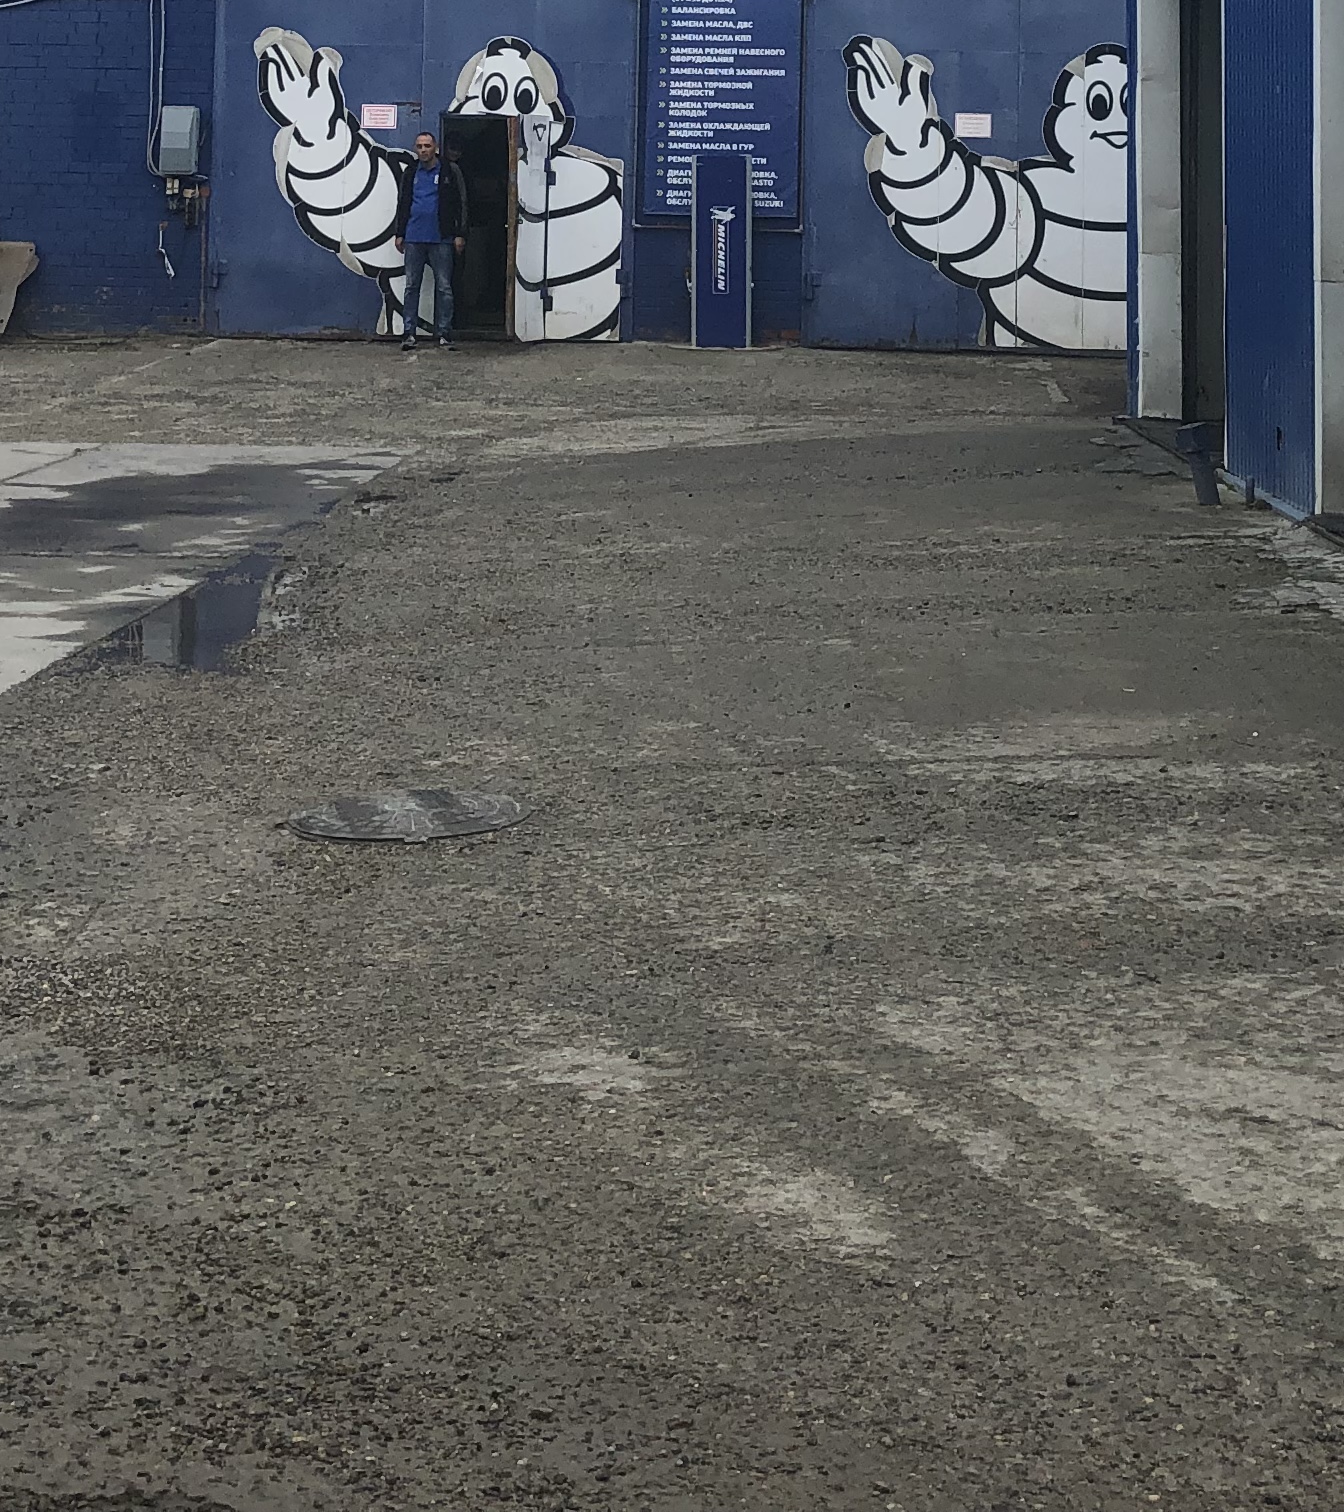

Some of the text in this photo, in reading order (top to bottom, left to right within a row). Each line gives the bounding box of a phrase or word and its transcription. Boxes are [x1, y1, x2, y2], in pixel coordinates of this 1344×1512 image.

[671, 6, 736, 14] БАЛАНСИРОВКА
[671, 20, 704, 28] ЗАМЕНА
[671, 33, 704, 41] ЗАМЕНА
[705, 34, 734, 42] МАСЛА
[670, 46, 785, 56] ЗАМЕНА РЕМНЕЙ НАВЕСНОГО
[670, 55, 734, 63] ОБОРУДОВАНИЯ
[670, 67, 786, 77] ЗАМЕНА СВЕЧЕЙ ЗАЖИГАНИЯ
[703, 81, 753, 89] ТОРМОЗНОЙ
[669, 89, 714, 97] ЖИДКОСТИ
[668, 101, 754, 110] ЗАМЕНА ТОРМОЗНЫХ
[668, 109, 708, 117] КОЛОДОК
[668, 121, 771, 131] ЗАМЕНА ОХЛАЖДАЮЩЕЙ
[668, 129, 714, 138] ЖИДКОСТИ
[667, 142, 701, 150] ЗАМЕНА
[702, 142, 731, 150] МАСЛА
[738, 143, 755, 151] ГУР
[754, 200, 784, 208] SUZUKI
[717, 224, 727, 291] MICHELIN
